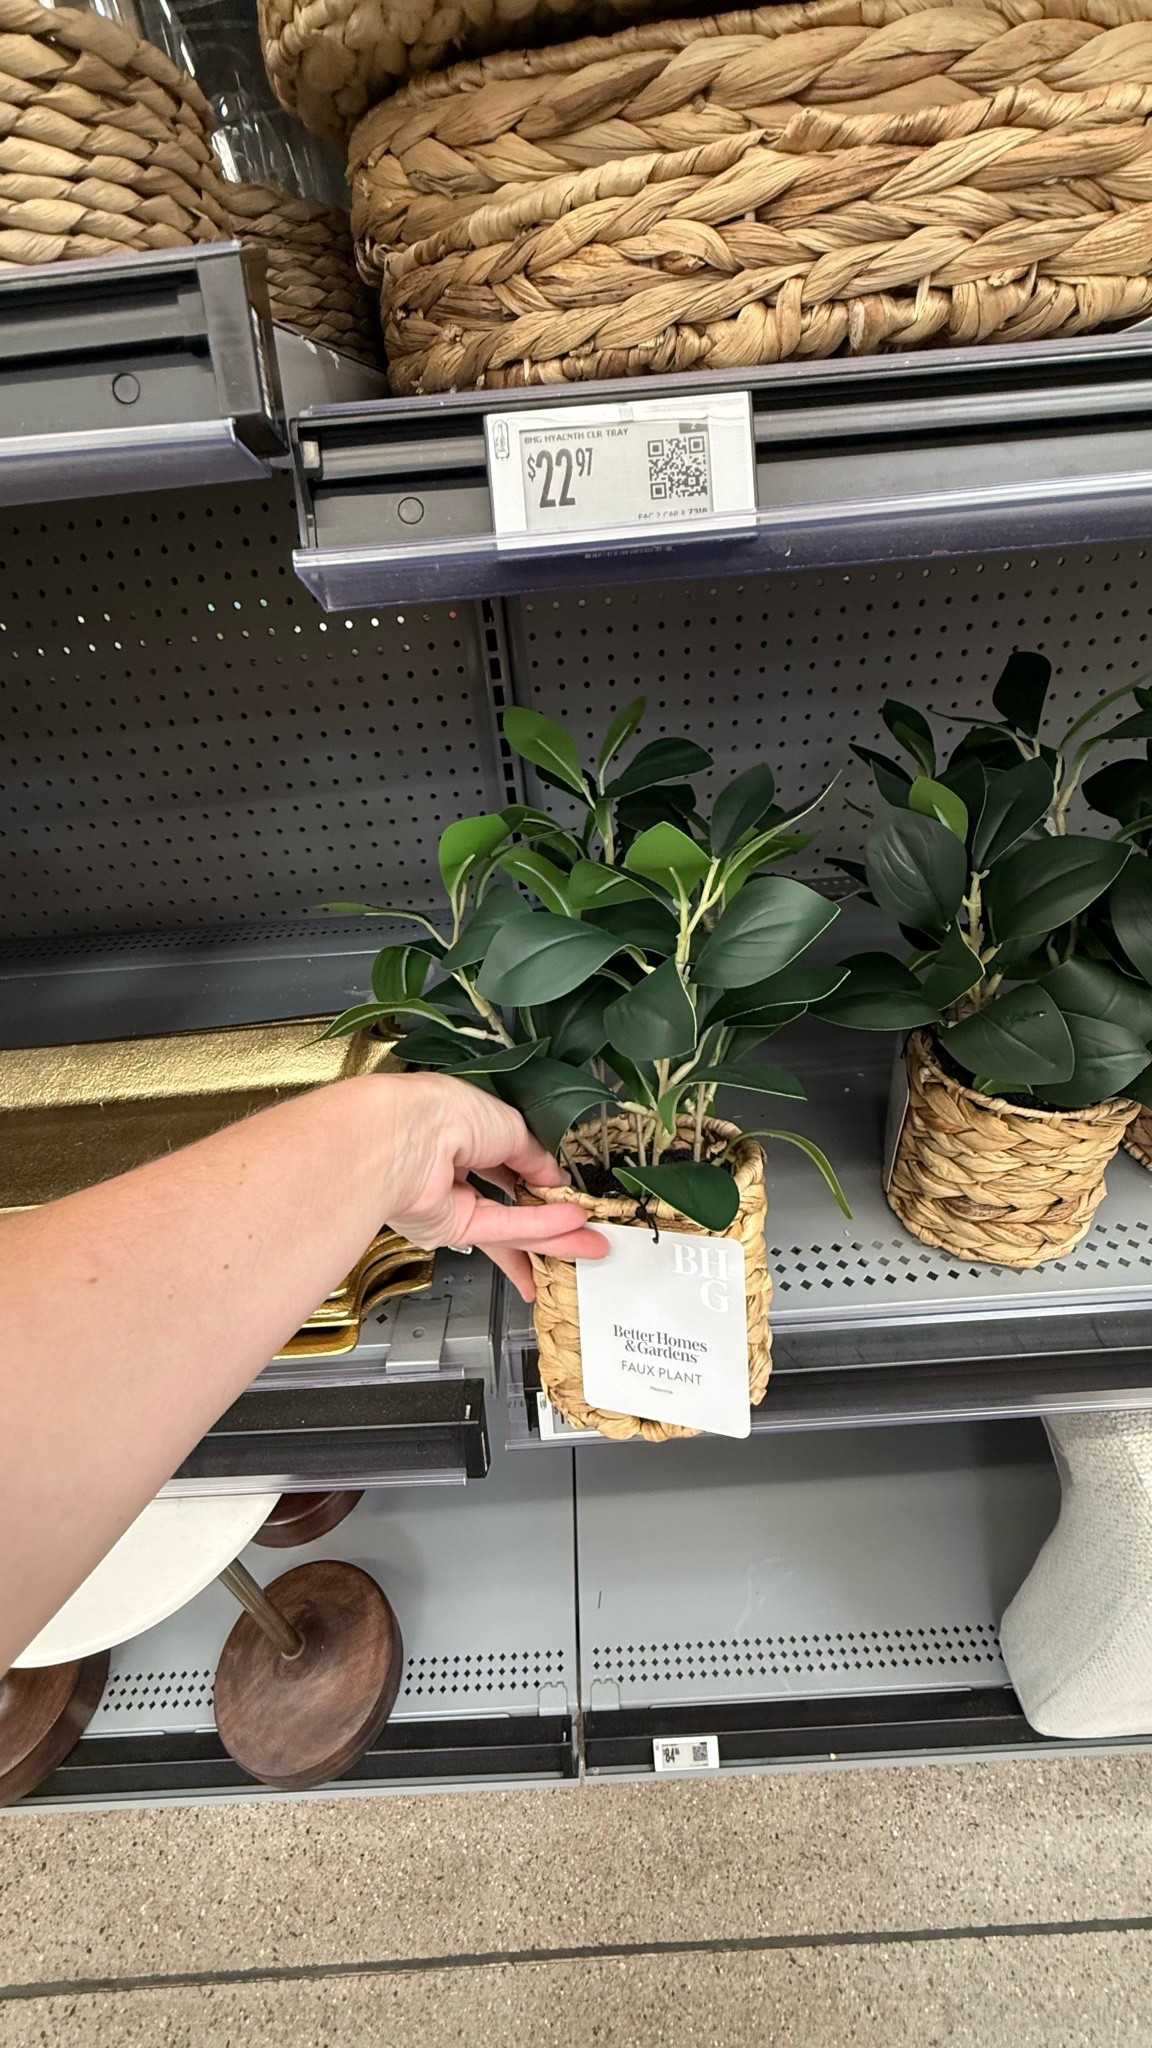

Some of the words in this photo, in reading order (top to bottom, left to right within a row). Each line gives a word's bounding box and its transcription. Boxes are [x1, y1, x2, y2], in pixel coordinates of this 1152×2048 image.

[524, 435, 542, 445] BHG
[544, 431, 584, 443] HYACNTH
[586, 429, 602, 440] CLR
[606, 428, 629, 437] TRAY
[700, 1280, 730, 1312] G
[613, 1323, 655, 1343] Better
[656, 1331, 708, 1353] Homes
[621, 1360, 655, 1377] FAUX
[658, 1367, 702, 1385] PLANT
